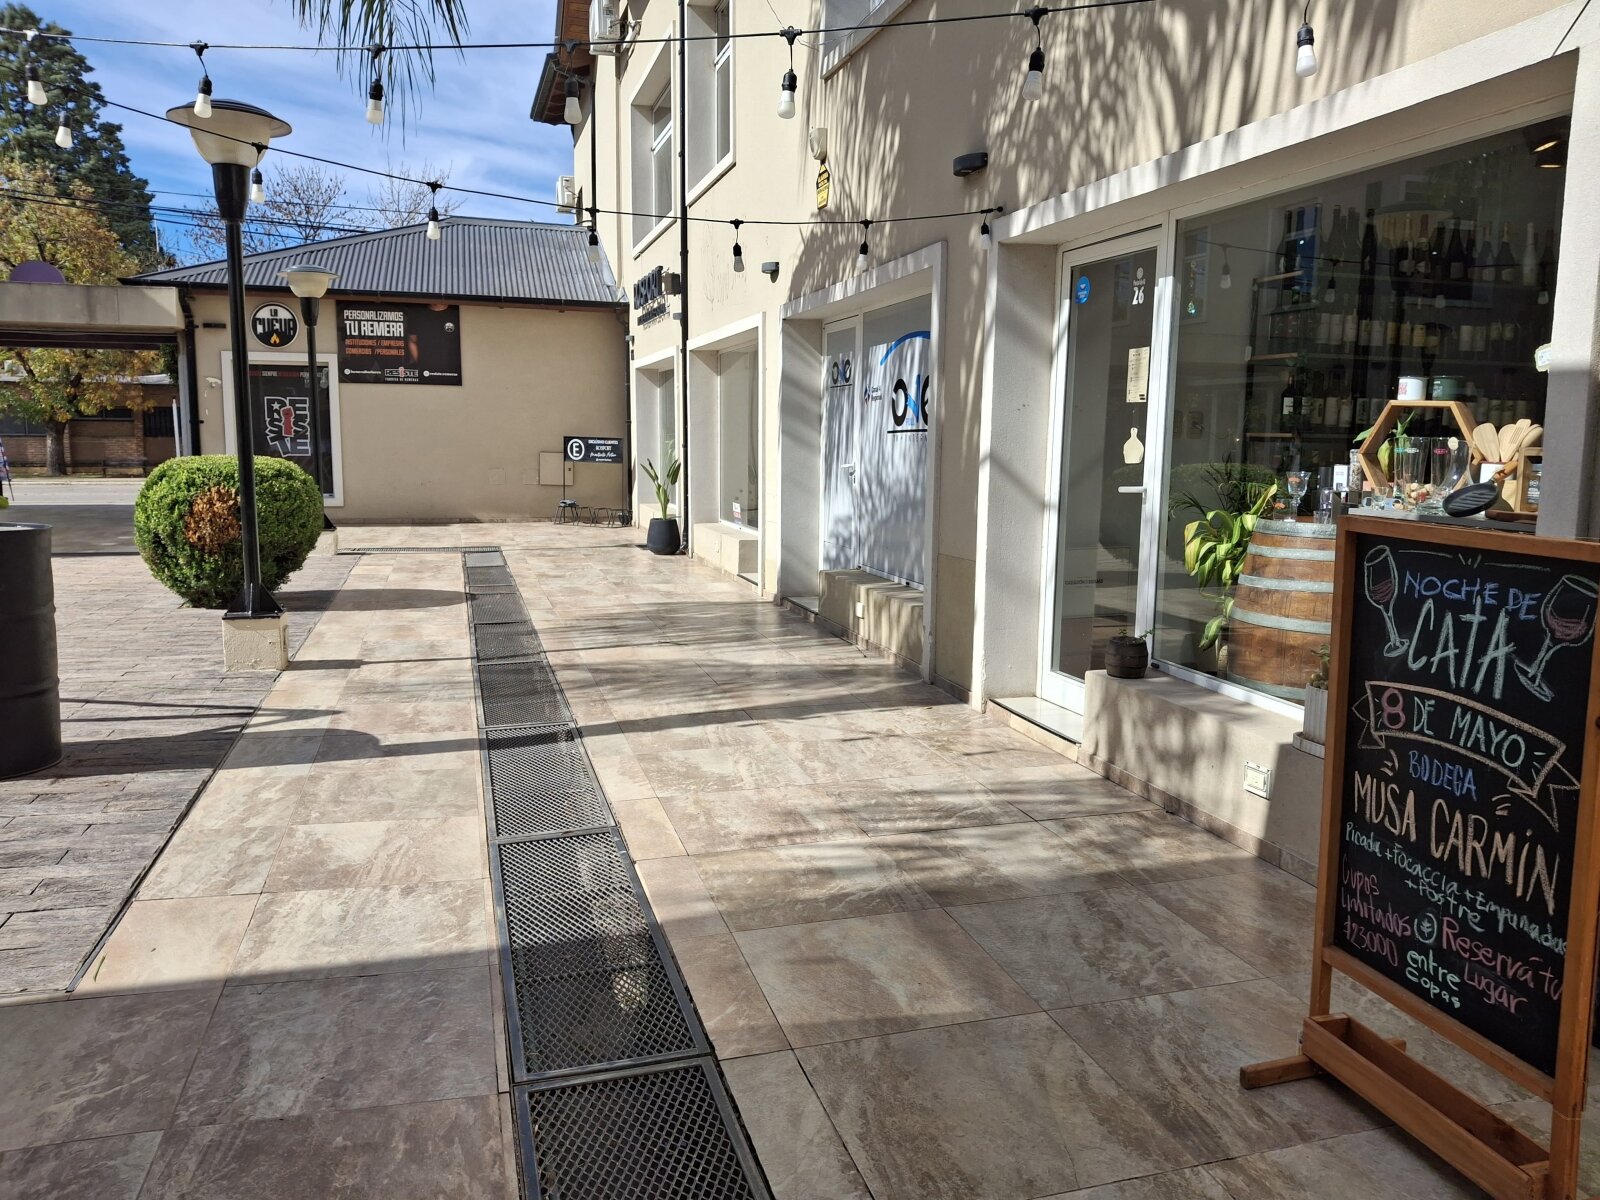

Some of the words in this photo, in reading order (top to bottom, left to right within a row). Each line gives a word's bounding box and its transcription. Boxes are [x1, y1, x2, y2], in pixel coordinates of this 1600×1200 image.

[270, 308, 279, 318] LA
[343, 309, 404, 321] PERSONALIZAMOS
[1132, 286, 1145, 305] 26
[255, 317, 295, 336] CUEVA
[344, 320, 359, 336] TU
[360, 320, 405, 337] REMERA
[572, 442, 580, 457] E
[1403, 570, 1499, 606] NOCHE
[1507, 588, 1543, 621] DE
[1407, 595, 1518, 700] CATA
[1381, 688, 1406, 730] 8
[1412, 696, 1435, 736] DE
[1449, 705, 1526, 769] MAYO
[1408, 750, 1477, 802] BODEGA
[1354, 770, 1417, 843] MUSA
[1342, 853, 1380, 899] Cupos
[1406, 949, 1462, 992] entre
